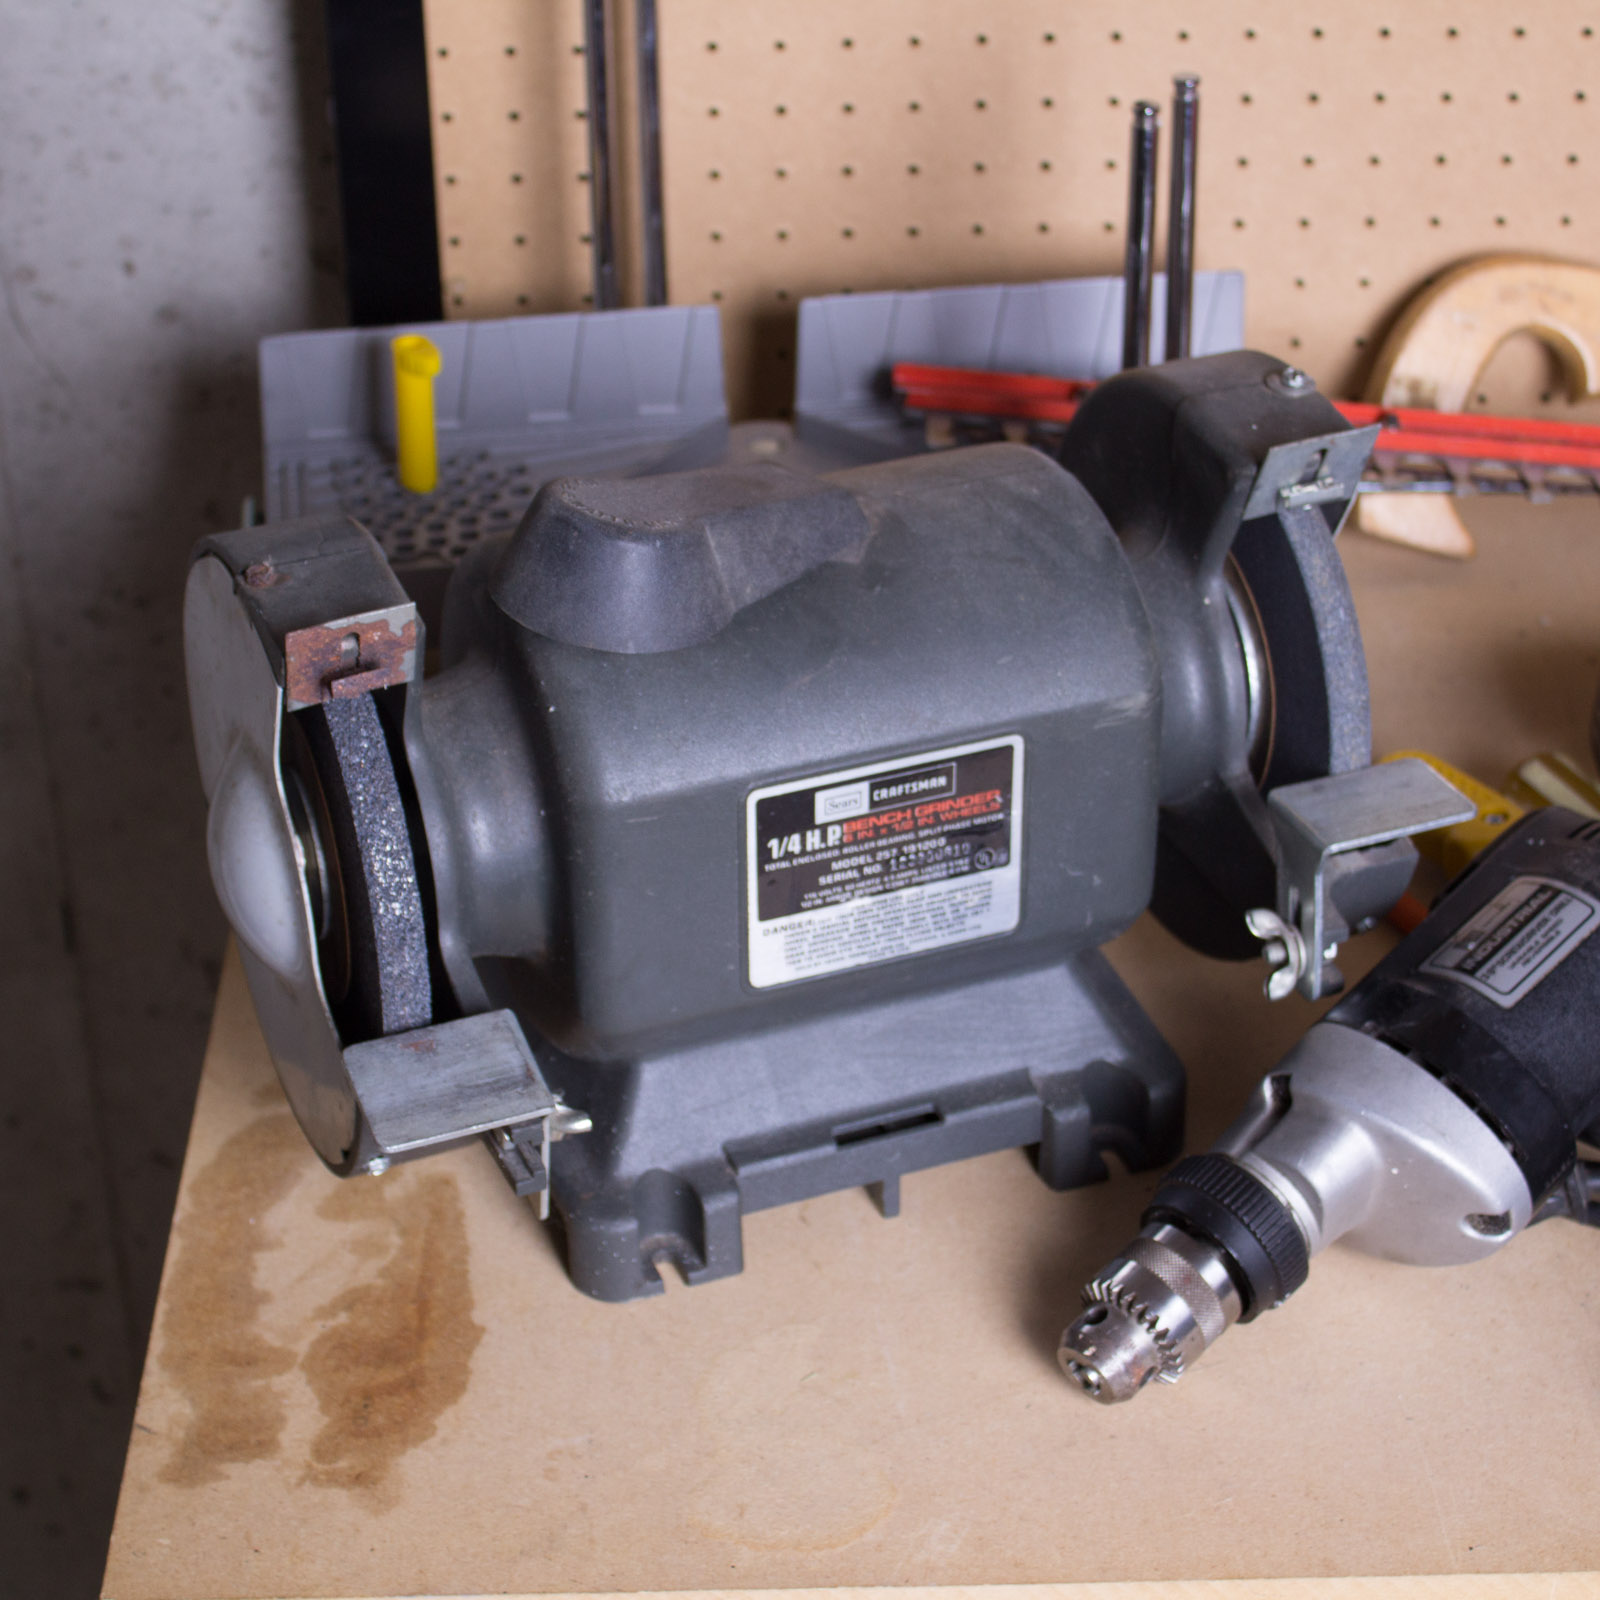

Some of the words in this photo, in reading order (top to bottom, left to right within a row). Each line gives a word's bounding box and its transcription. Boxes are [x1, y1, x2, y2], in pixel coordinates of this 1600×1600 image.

[873, 776, 947, 800] CRAFTSMAN
[828, 798, 858, 808] Sears
[842, 809, 912, 833] BENCH
[914, 789, 1001, 816] GRINDER
[939, 799, 1000, 820] WHEELS
[764, 860, 791, 871] TOTAL
[842, 841, 876, 854] ROLLER
[918, 826, 942, 837] SPLIT
[943, 820, 971, 831] PHASE
[972, 812, 1005, 824] MOTOR
[767, 833, 802, 859] 1/4
[805, 824, 842, 851] H.P.
[831, 854, 873, 870] MODEL
[818, 869, 860, 885] SERIAL
[1463, 892, 1551, 969] INDUSTRIAL
